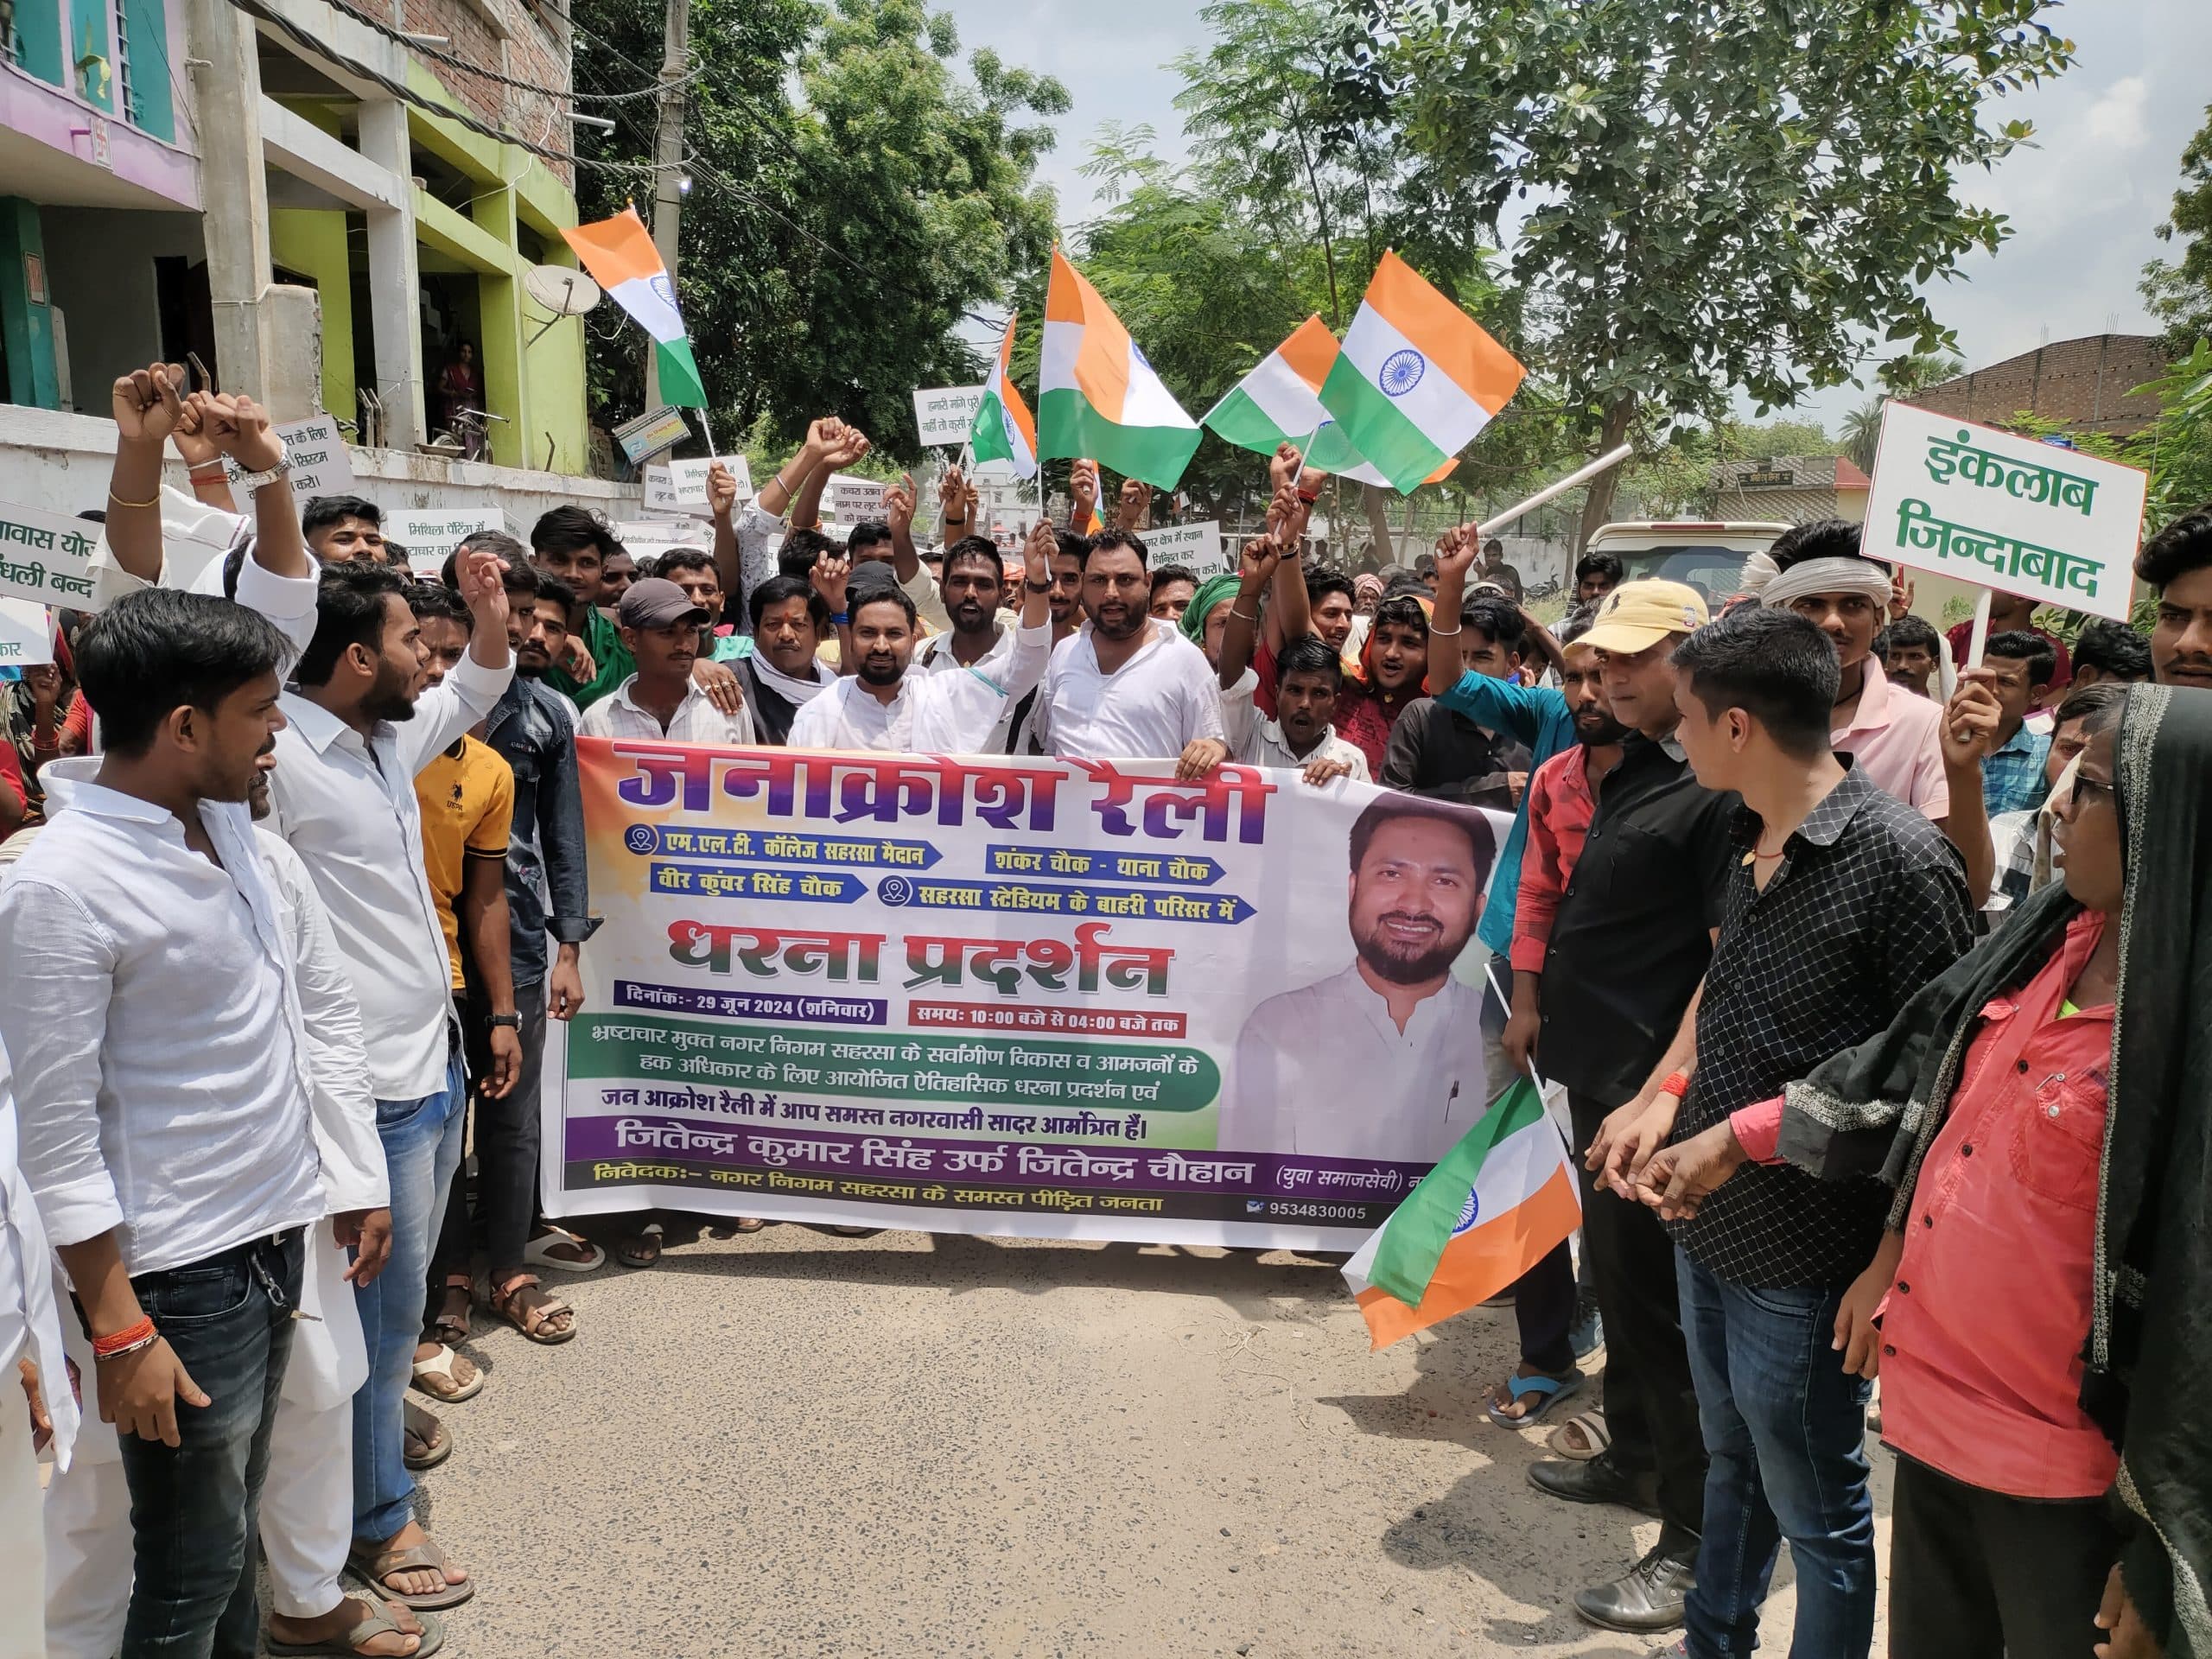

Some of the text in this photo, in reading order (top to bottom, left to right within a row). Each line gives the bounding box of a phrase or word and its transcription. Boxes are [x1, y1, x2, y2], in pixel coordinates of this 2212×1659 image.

[295, 430, 307, 443] के
[309, 427, 328, 442] लिए
[295, 451, 328, 467] सिस्टम
[1924, 429, 2100, 517] इंकलाब
[409, 522, 444, 536] मिथिला
[1896, 498, 2106, 598] जिन्दाबाद
[50, 572, 95, 599] बन्द
[613, 741, 1279, 845] जनाक्रोश रैली
[664, 832, 925, 865] एम.एल.टी. कॉलेज सहरसा मैदान
[995, 848, 1043, 870] शंकर
[1050, 849, 1091, 873] चौक
[1117, 859, 1161, 878] थाना
[1168, 857, 1211, 880] चौक
[658, 869, 844, 897] वीर कुंवर सिंह चौक
[918, 886, 1238, 921] सहरसा स्टेडियम के बाहरी परिसर में
[667, 919, 1176, 995] धरना प्रदर्शन
[697, 995, 716, 1009] 29
[720, 997, 752, 1014] जून
[754, 999, 793, 1014] 2024
[797, 997, 875, 1021] (शनिवार)
[917, 1007, 1179, 1032] समय: 10:00 बजे से 04:00 बजे तक
[592, 1026, 1199, 1075] भ्रष्टाचार मुक्त नगर निगम सहरसा के सर्वांगीण विकास व आमजनों के
[639, 1055, 1161, 1101] हक अधिकार के लिए आयोजित ऐतिहासिक धरना प्रदर्शन एवं
[601, 1085, 1147, 1141] जन आक्रोश रैली में आप समस्त नगरवासी सादर आमंत्रित हैं।
[615, 1118, 739, 1154] जितेन्द्र
[747, 1135, 854, 1166] कुमार
[861, 1138, 936, 1170] सिंह
[943, 1145, 1008, 1173] उर्फ
[1016, 1147, 1139, 1181] जितेन्द्र
[1147, 1153, 1256, 1184] चौहान
[1275, 1165, 1313, 1189] (युवा
[1318, 1168, 1403, 1192] समाजसेवी)
[709, 1170, 764, 1187] नगर
[768, 1171, 834, 1192] निगम
[839, 1180, 916, 1200] सहरसा
[922, 1185, 948, 1201] के
[953, 1189, 1025, 1205] समस्त
[1031, 1190, 1094, 1211] पीड़ित
[1099, 1197, 1164, 1211] जनता
[1269, 1202, 1366, 1219] 9534830005
